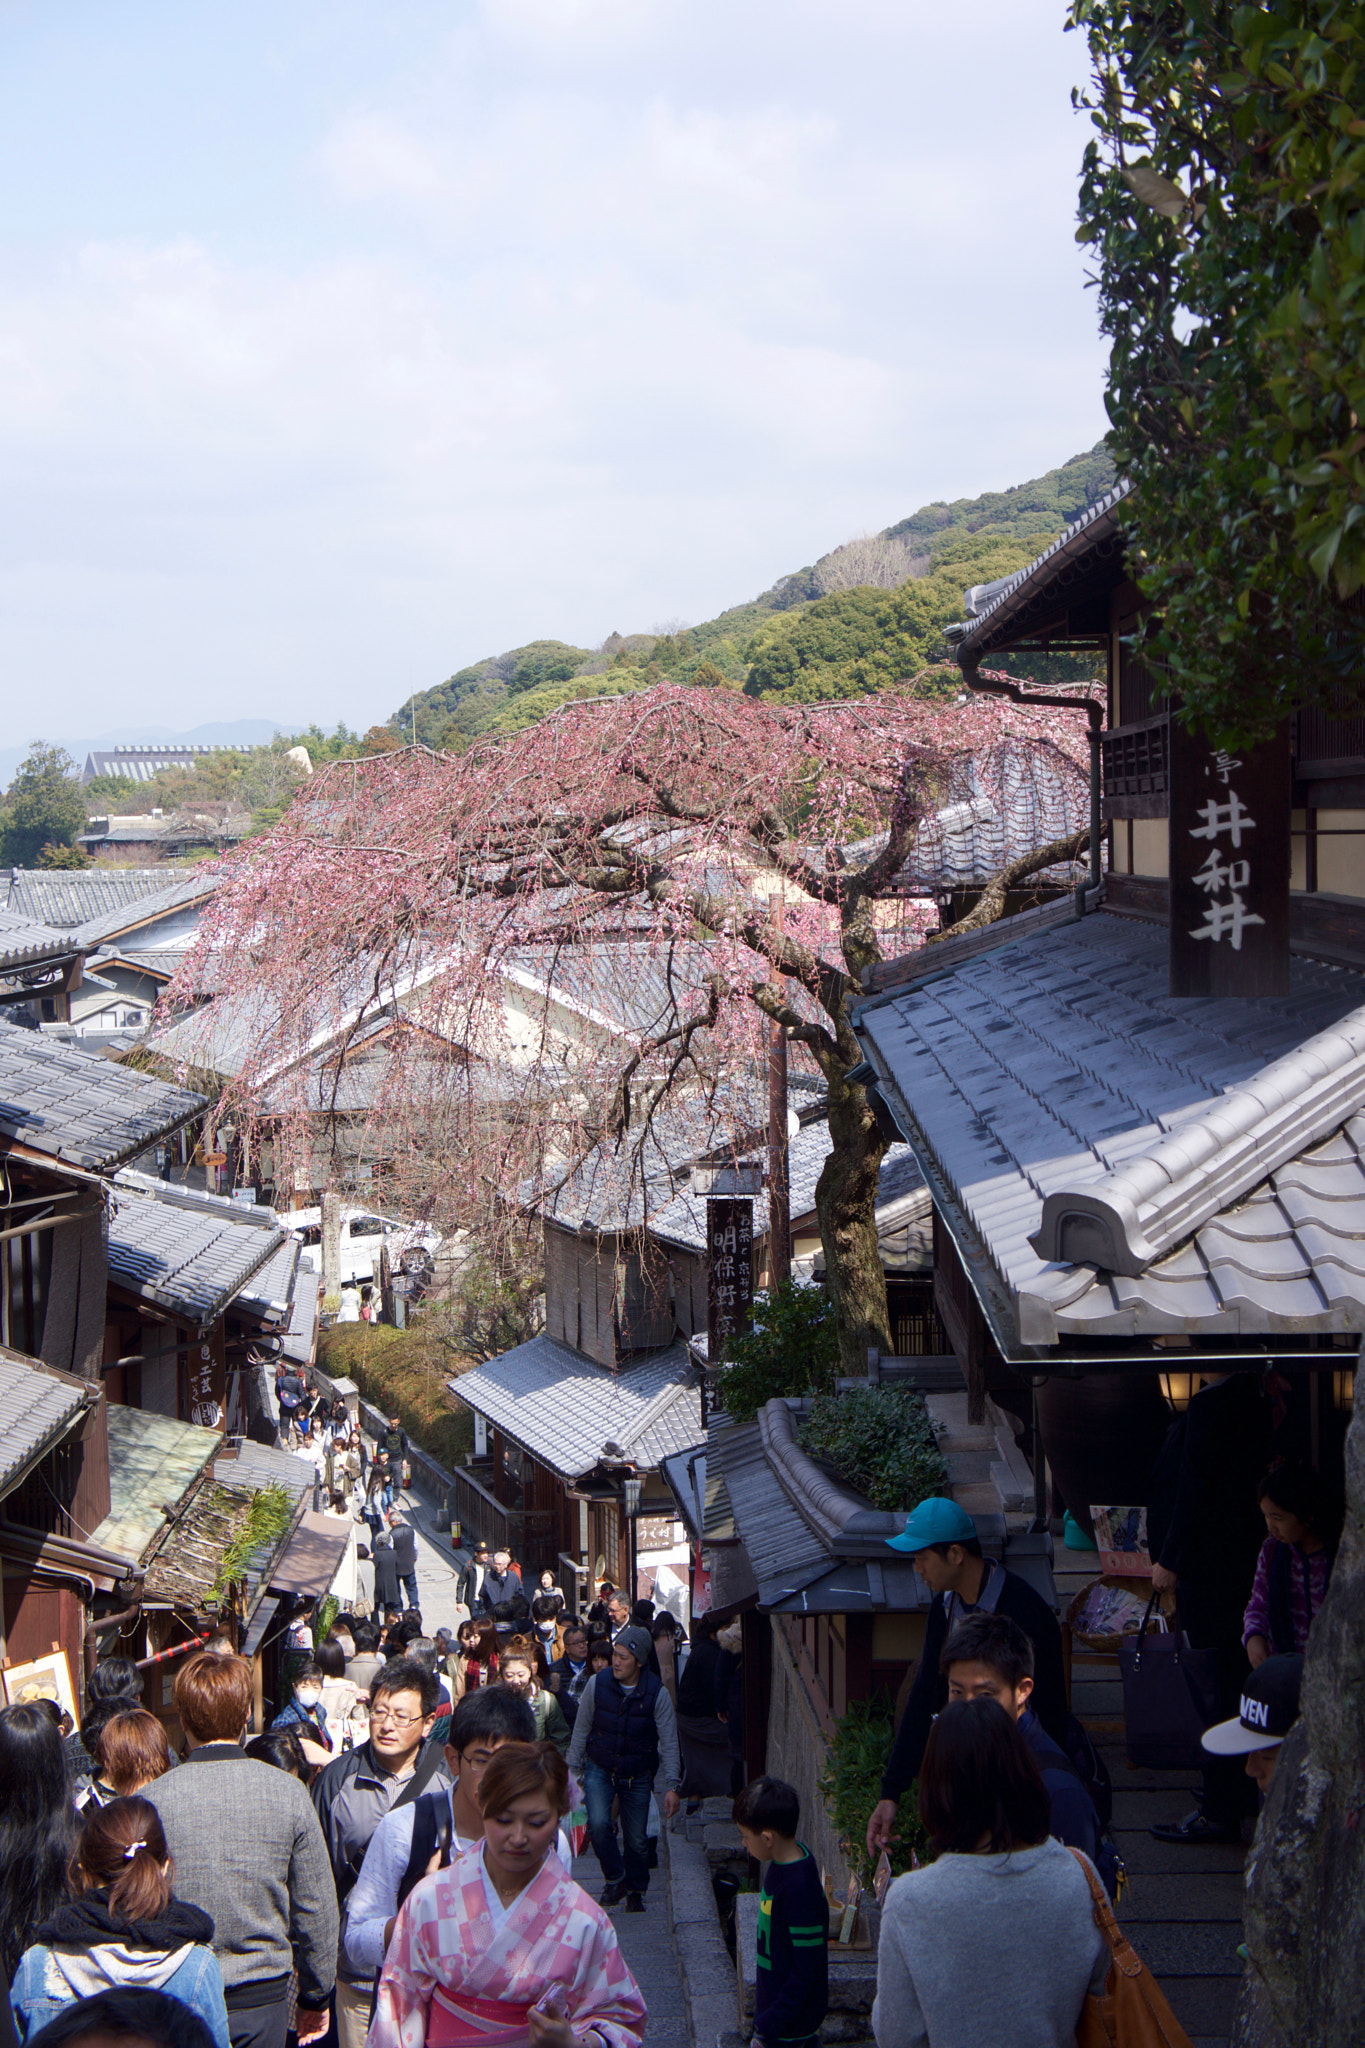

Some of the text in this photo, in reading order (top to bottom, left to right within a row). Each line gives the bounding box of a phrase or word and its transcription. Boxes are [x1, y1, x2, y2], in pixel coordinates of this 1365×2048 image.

[1189, 789, 1266, 951] 井和井
[1240, 1693, 1269, 1727] VEN
